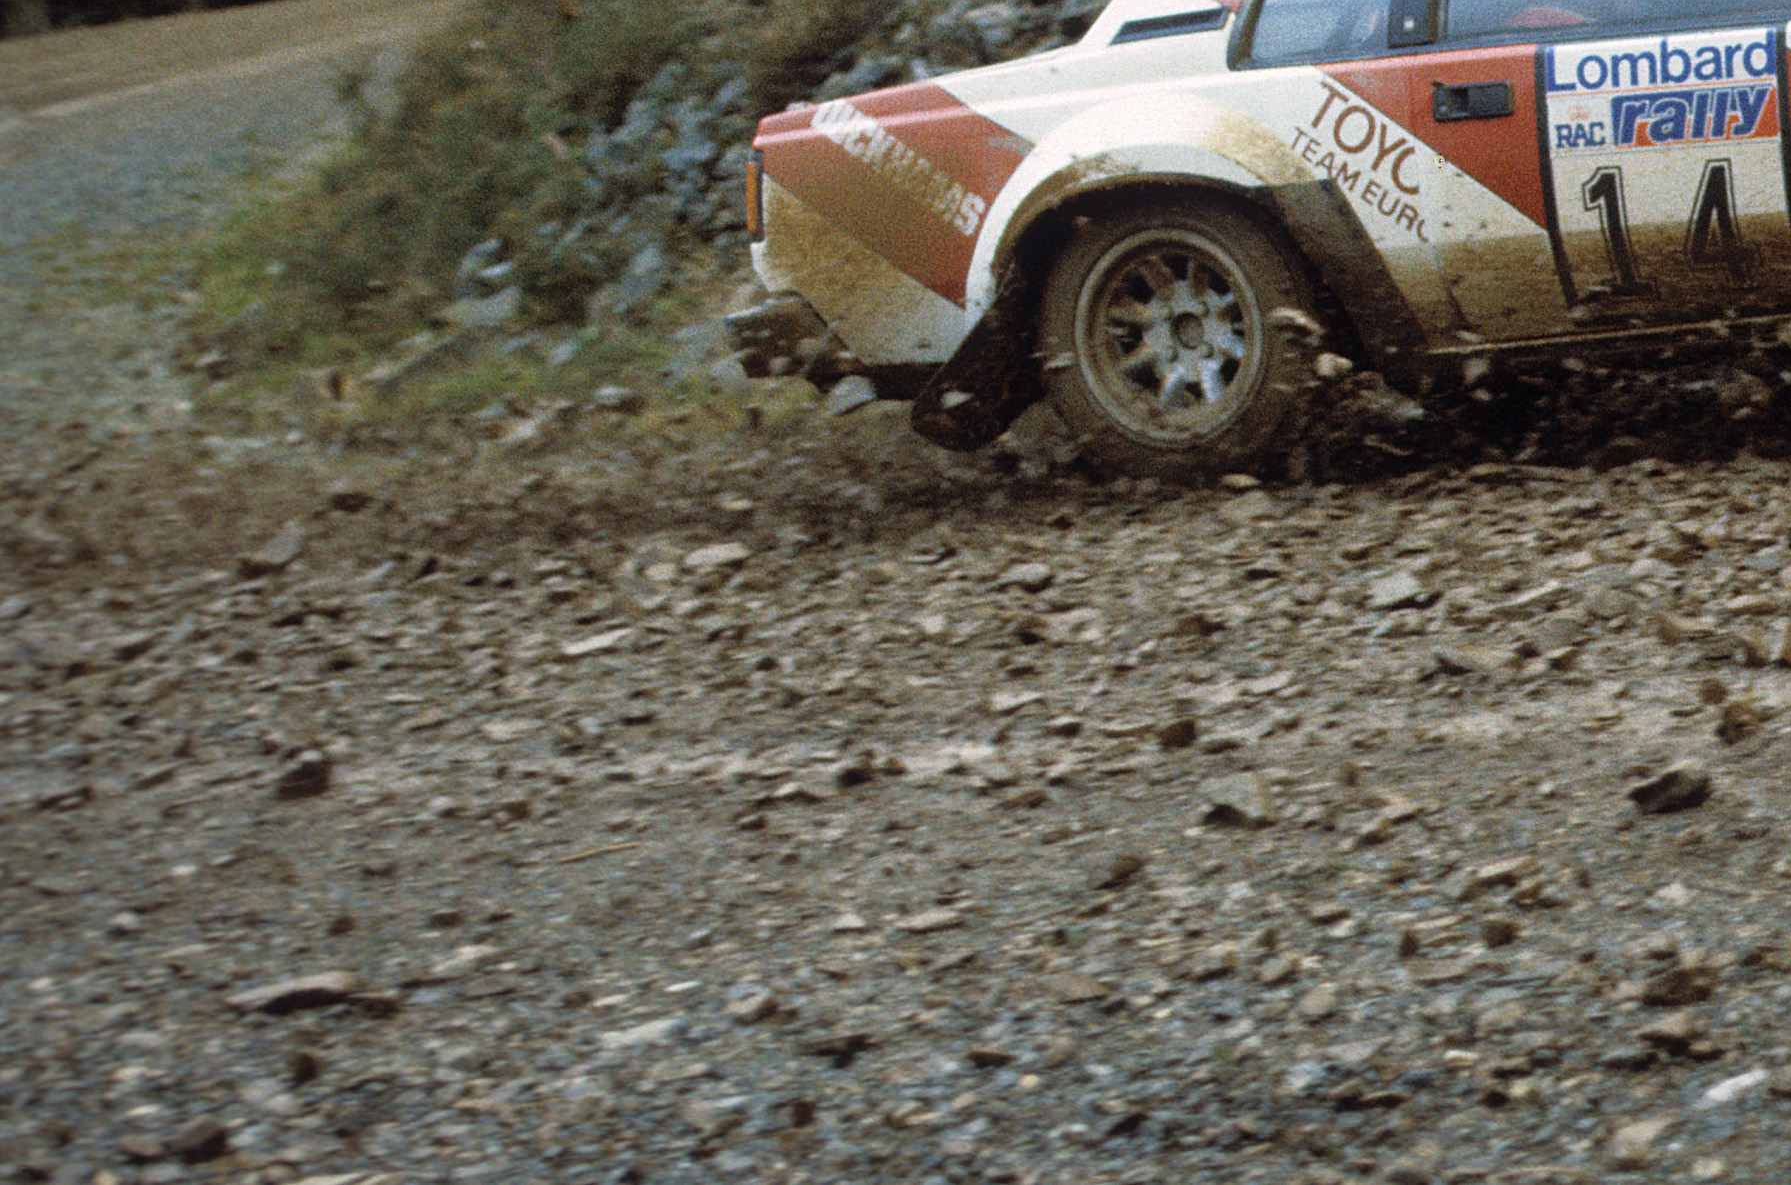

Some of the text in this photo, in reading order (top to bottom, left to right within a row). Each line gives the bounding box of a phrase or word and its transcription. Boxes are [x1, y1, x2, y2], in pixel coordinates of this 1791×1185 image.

[1547, 30, 1777, 92] Lombard
[1555, 121, 1606, 149] RAC
[1616, 86, 1774, 147] rally
[1291, 126, 1361, 191] TEAM
